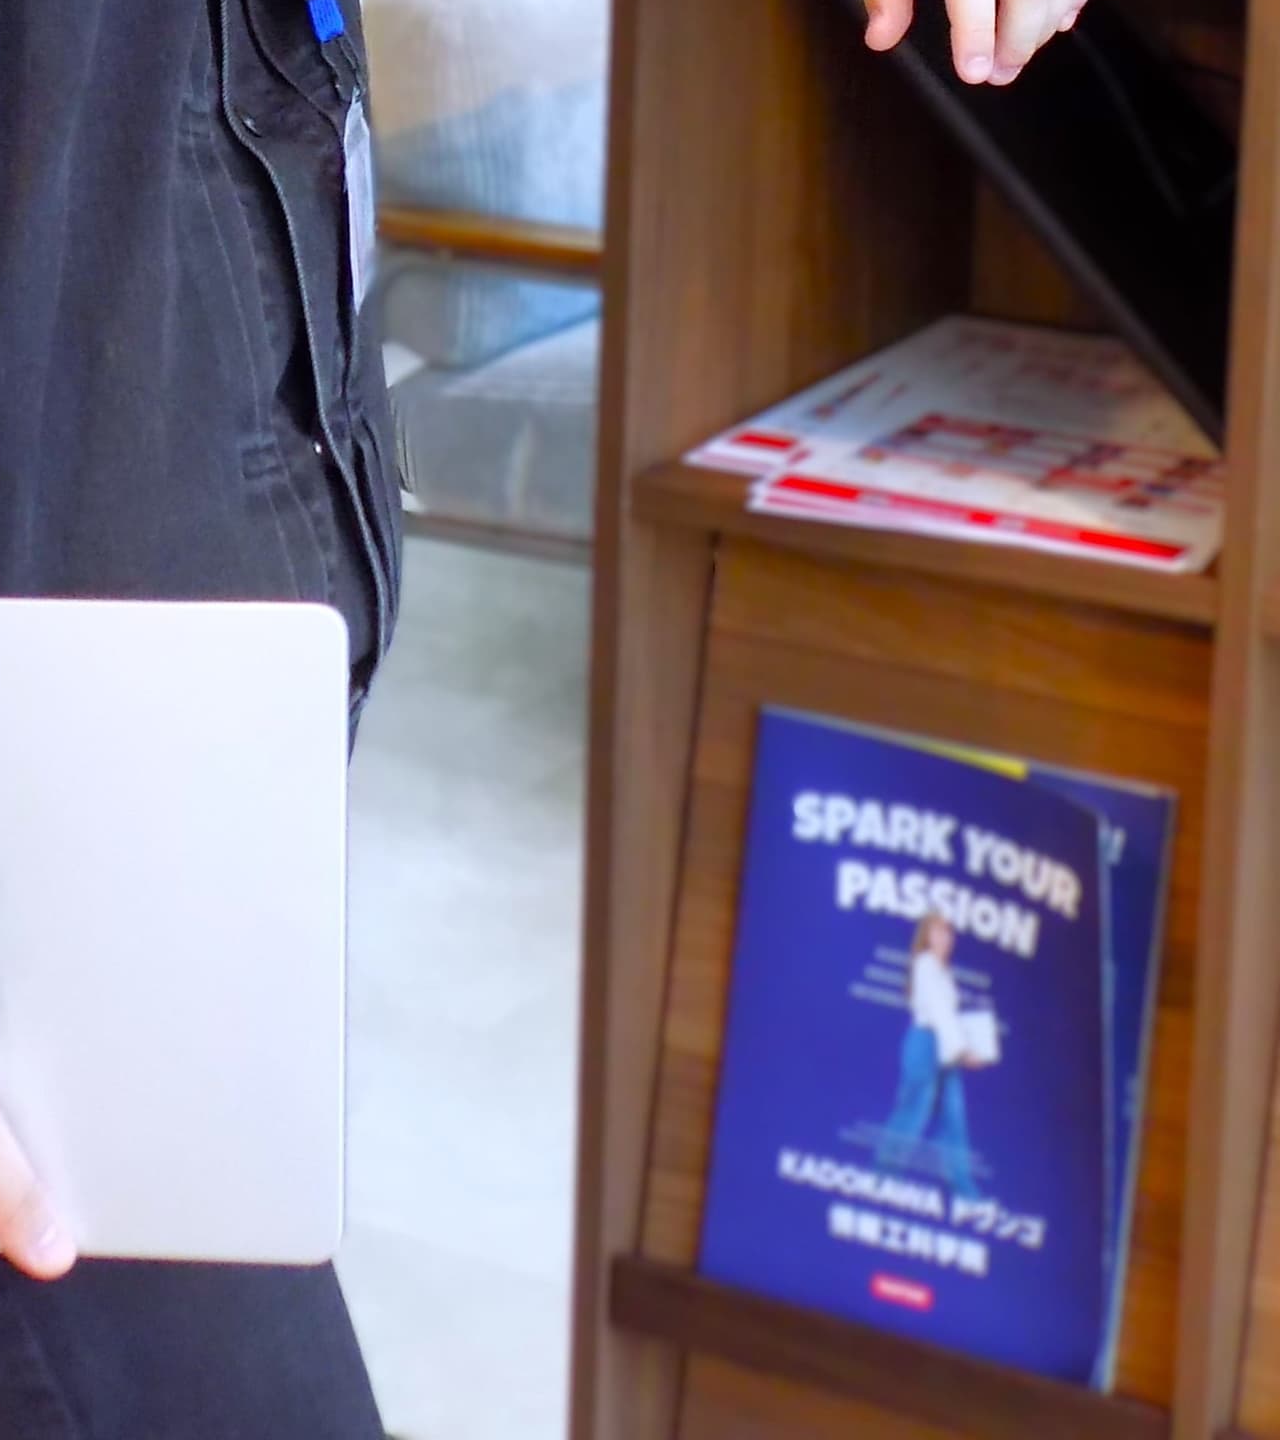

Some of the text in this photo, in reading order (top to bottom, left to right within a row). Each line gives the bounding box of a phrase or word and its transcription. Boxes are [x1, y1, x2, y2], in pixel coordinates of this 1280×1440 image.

[793, 793, 955, 862] SPARK
[965, 825, 1080, 917] YOUR
[837, 861, 1038, 957] PASSION
[779, 1149, 943, 1218] KADOKAWA
